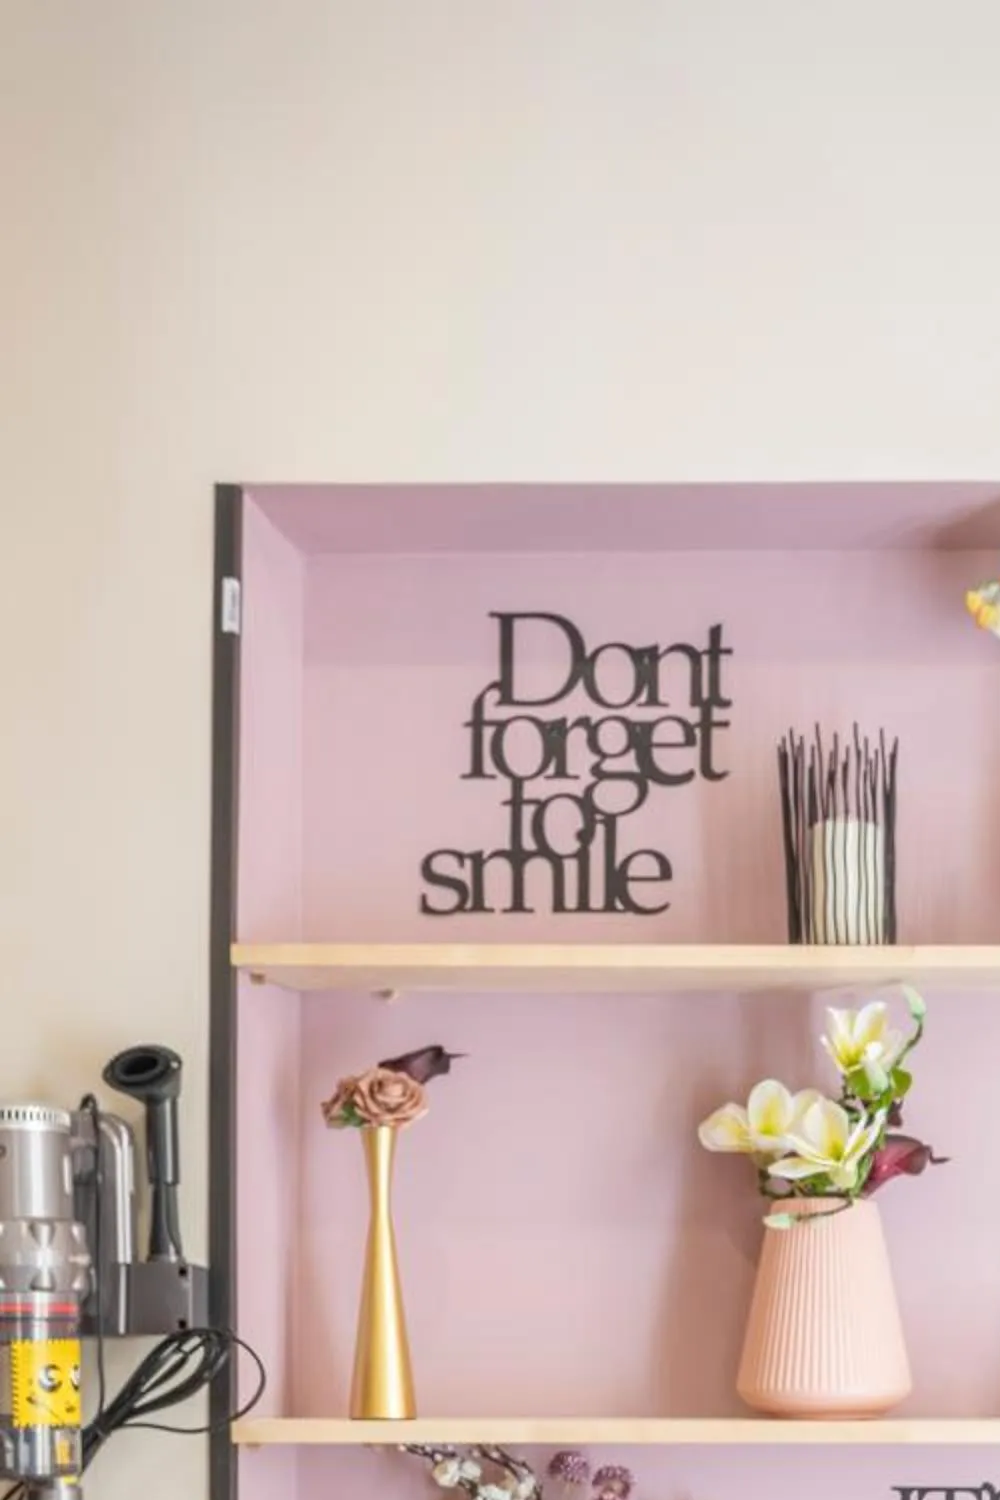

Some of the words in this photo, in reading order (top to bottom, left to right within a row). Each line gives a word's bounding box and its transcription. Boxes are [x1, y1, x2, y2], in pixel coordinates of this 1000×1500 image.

[488, 611, 733, 709] Dont
[460, 680, 731, 817] forget
[419, 814, 673, 916] smile
[501, 777, 594, 858] to
